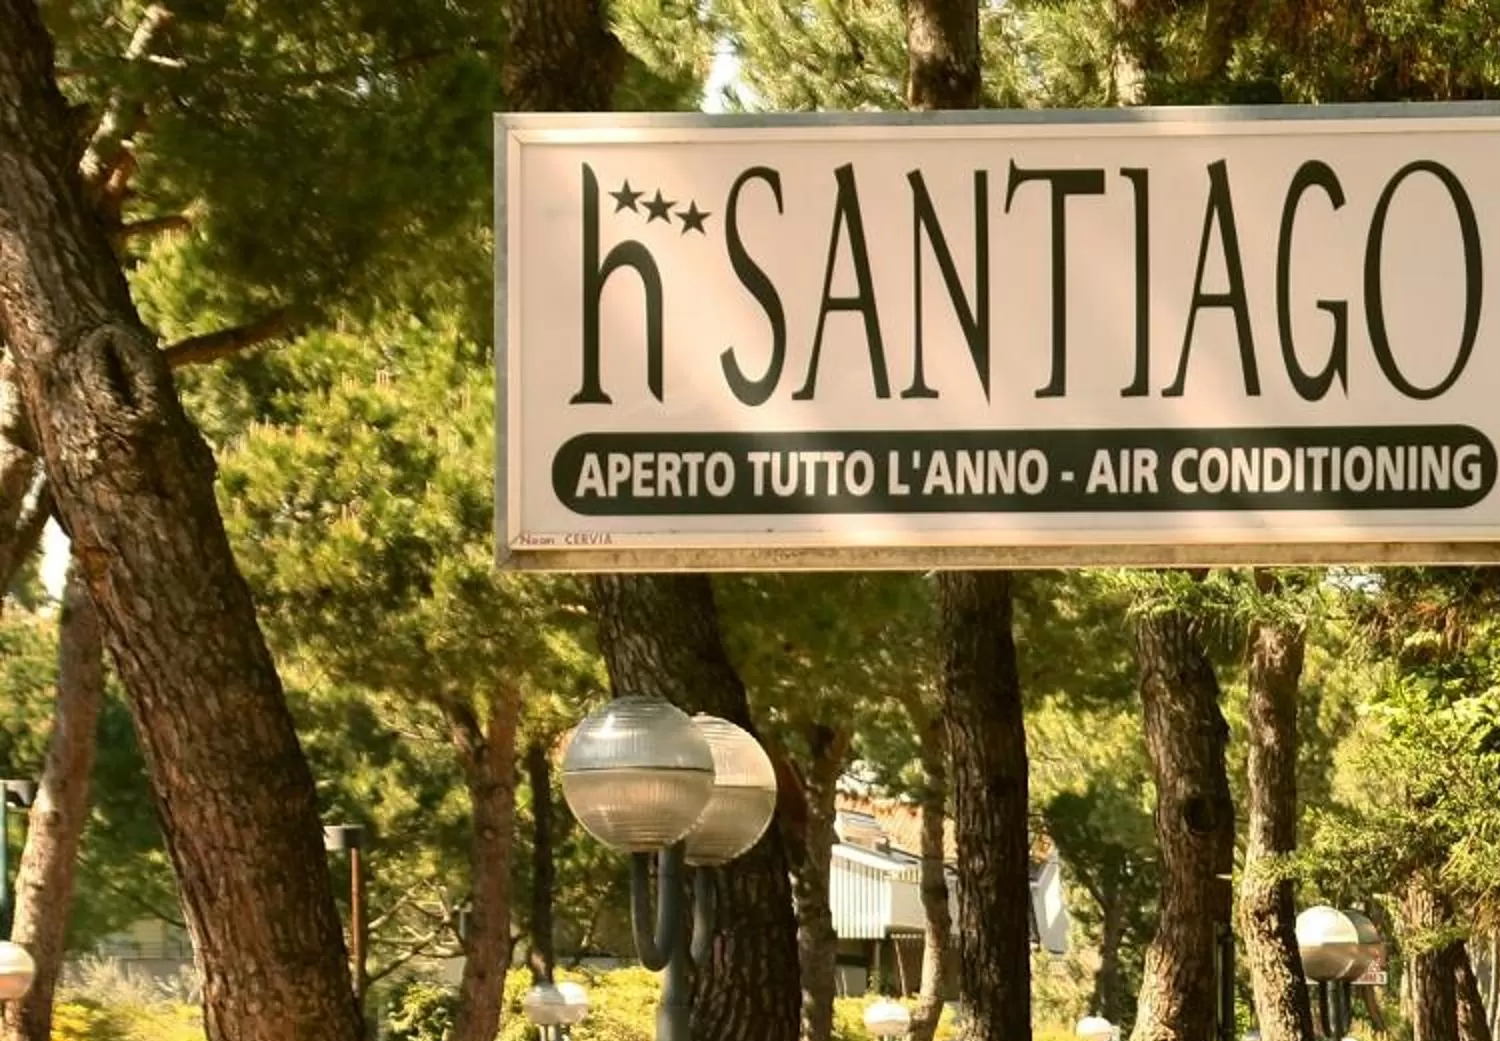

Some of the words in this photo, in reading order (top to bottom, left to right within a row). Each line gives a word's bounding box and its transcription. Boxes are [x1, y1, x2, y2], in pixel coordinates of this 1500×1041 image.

[720, 158, 1484, 407] SANTIAGO
[575, 451, 735, 497] APERTO
[747, 450, 875, 497] TUTTO
[888, 449, 1049, 495] L'ANNO
[1086, 448, 1159, 493] AIR
[1171, 444, 1481, 494] CONDITIONING
[565, 532, 613, 545] CERVIA
